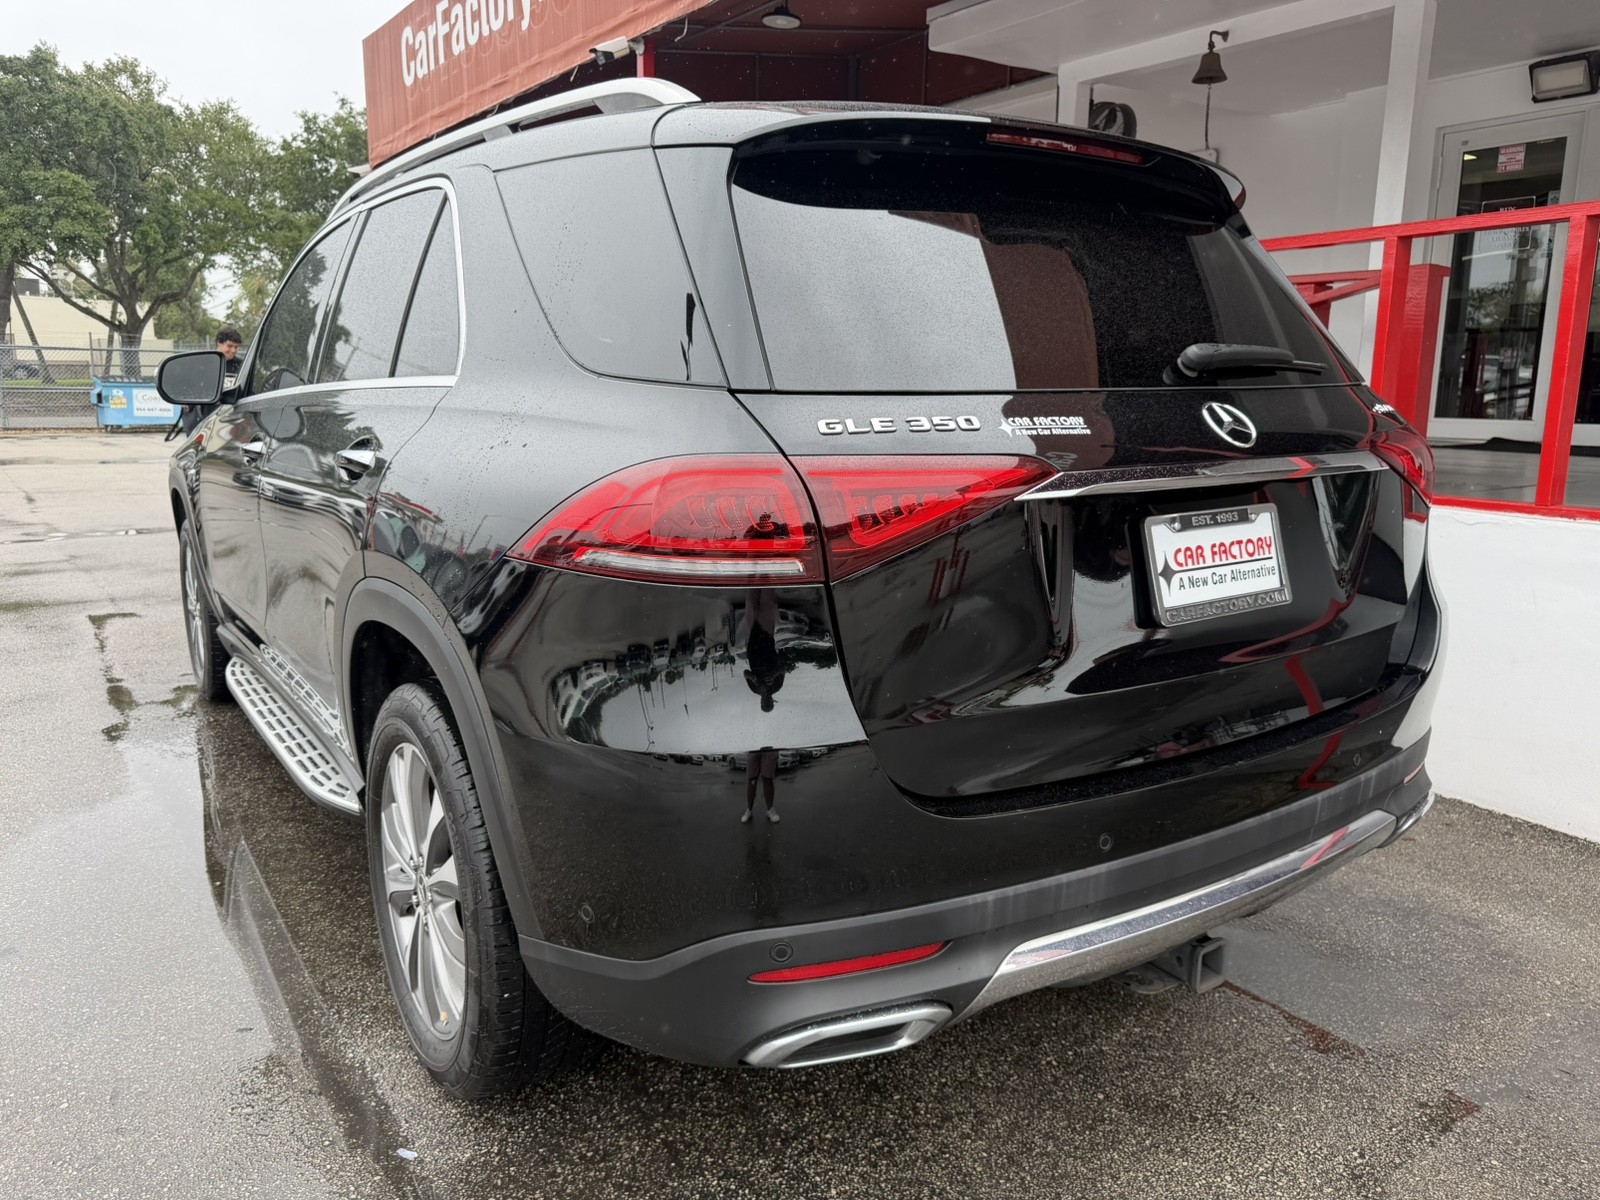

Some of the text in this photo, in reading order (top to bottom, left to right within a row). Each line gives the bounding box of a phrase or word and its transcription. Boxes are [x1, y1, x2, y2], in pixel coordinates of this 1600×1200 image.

[817, 415, 981, 435] GLE 350
[1007, 416, 1084, 426] CAR FACTORY
[1191, 512, 1239, 527] EST. 1993
[1173, 536, 1272, 568] CAR FACTORY
[1178, 564, 1276, 591] A New Car Alternative
[1166, 589, 1288, 623] CARFACTORY.COM
